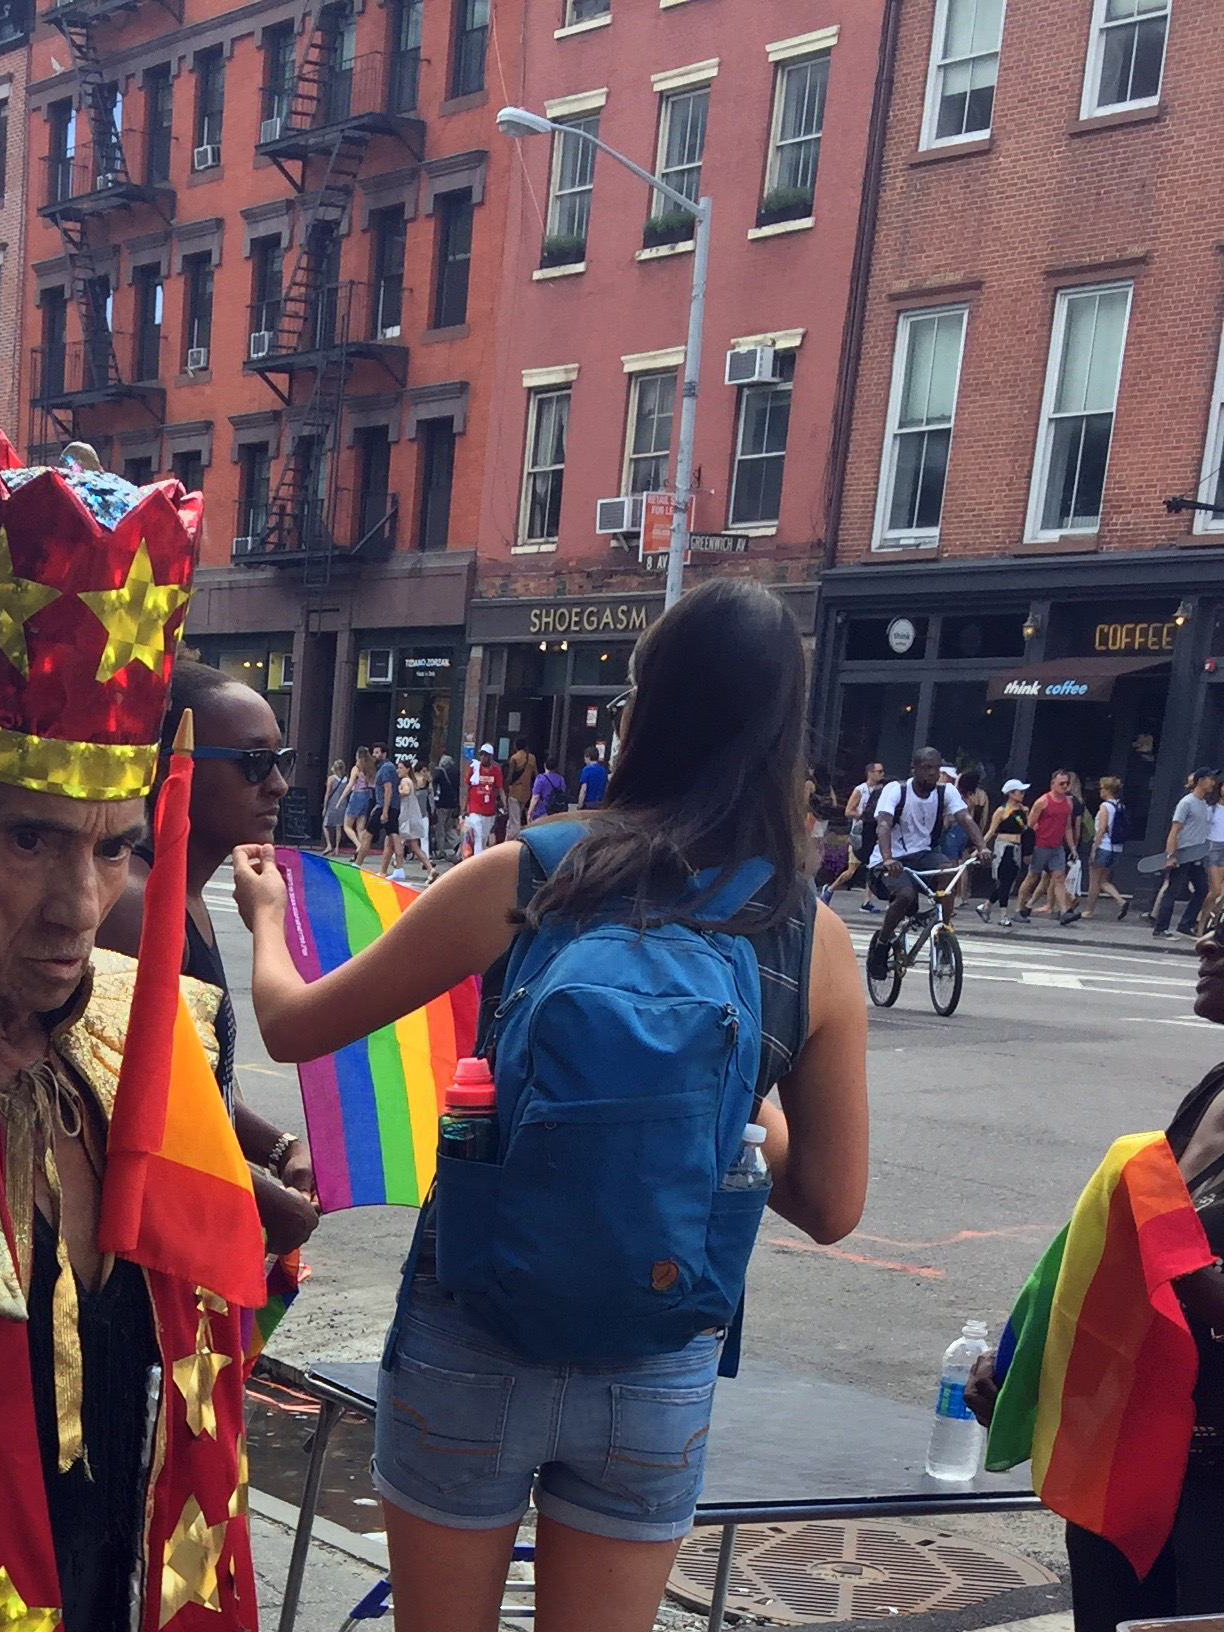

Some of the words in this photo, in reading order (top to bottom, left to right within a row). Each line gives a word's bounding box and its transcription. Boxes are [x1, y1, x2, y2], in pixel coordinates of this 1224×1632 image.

[690, 535, 733, 552] GREENWICH
[736, 537, 747, 552] AV
[656, 554, 669, 569] AV
[529, 604, 647, 632] SHOEGASM
[1094, 622, 1175, 650] COFFEE
[1003, 680, 1042, 695] think
[1045, 680, 1088, 695] coffee
[396, 717, 421, 729] 30%
[394, 735, 420, 748] 50%
[394, 753, 419, 768] 70%
